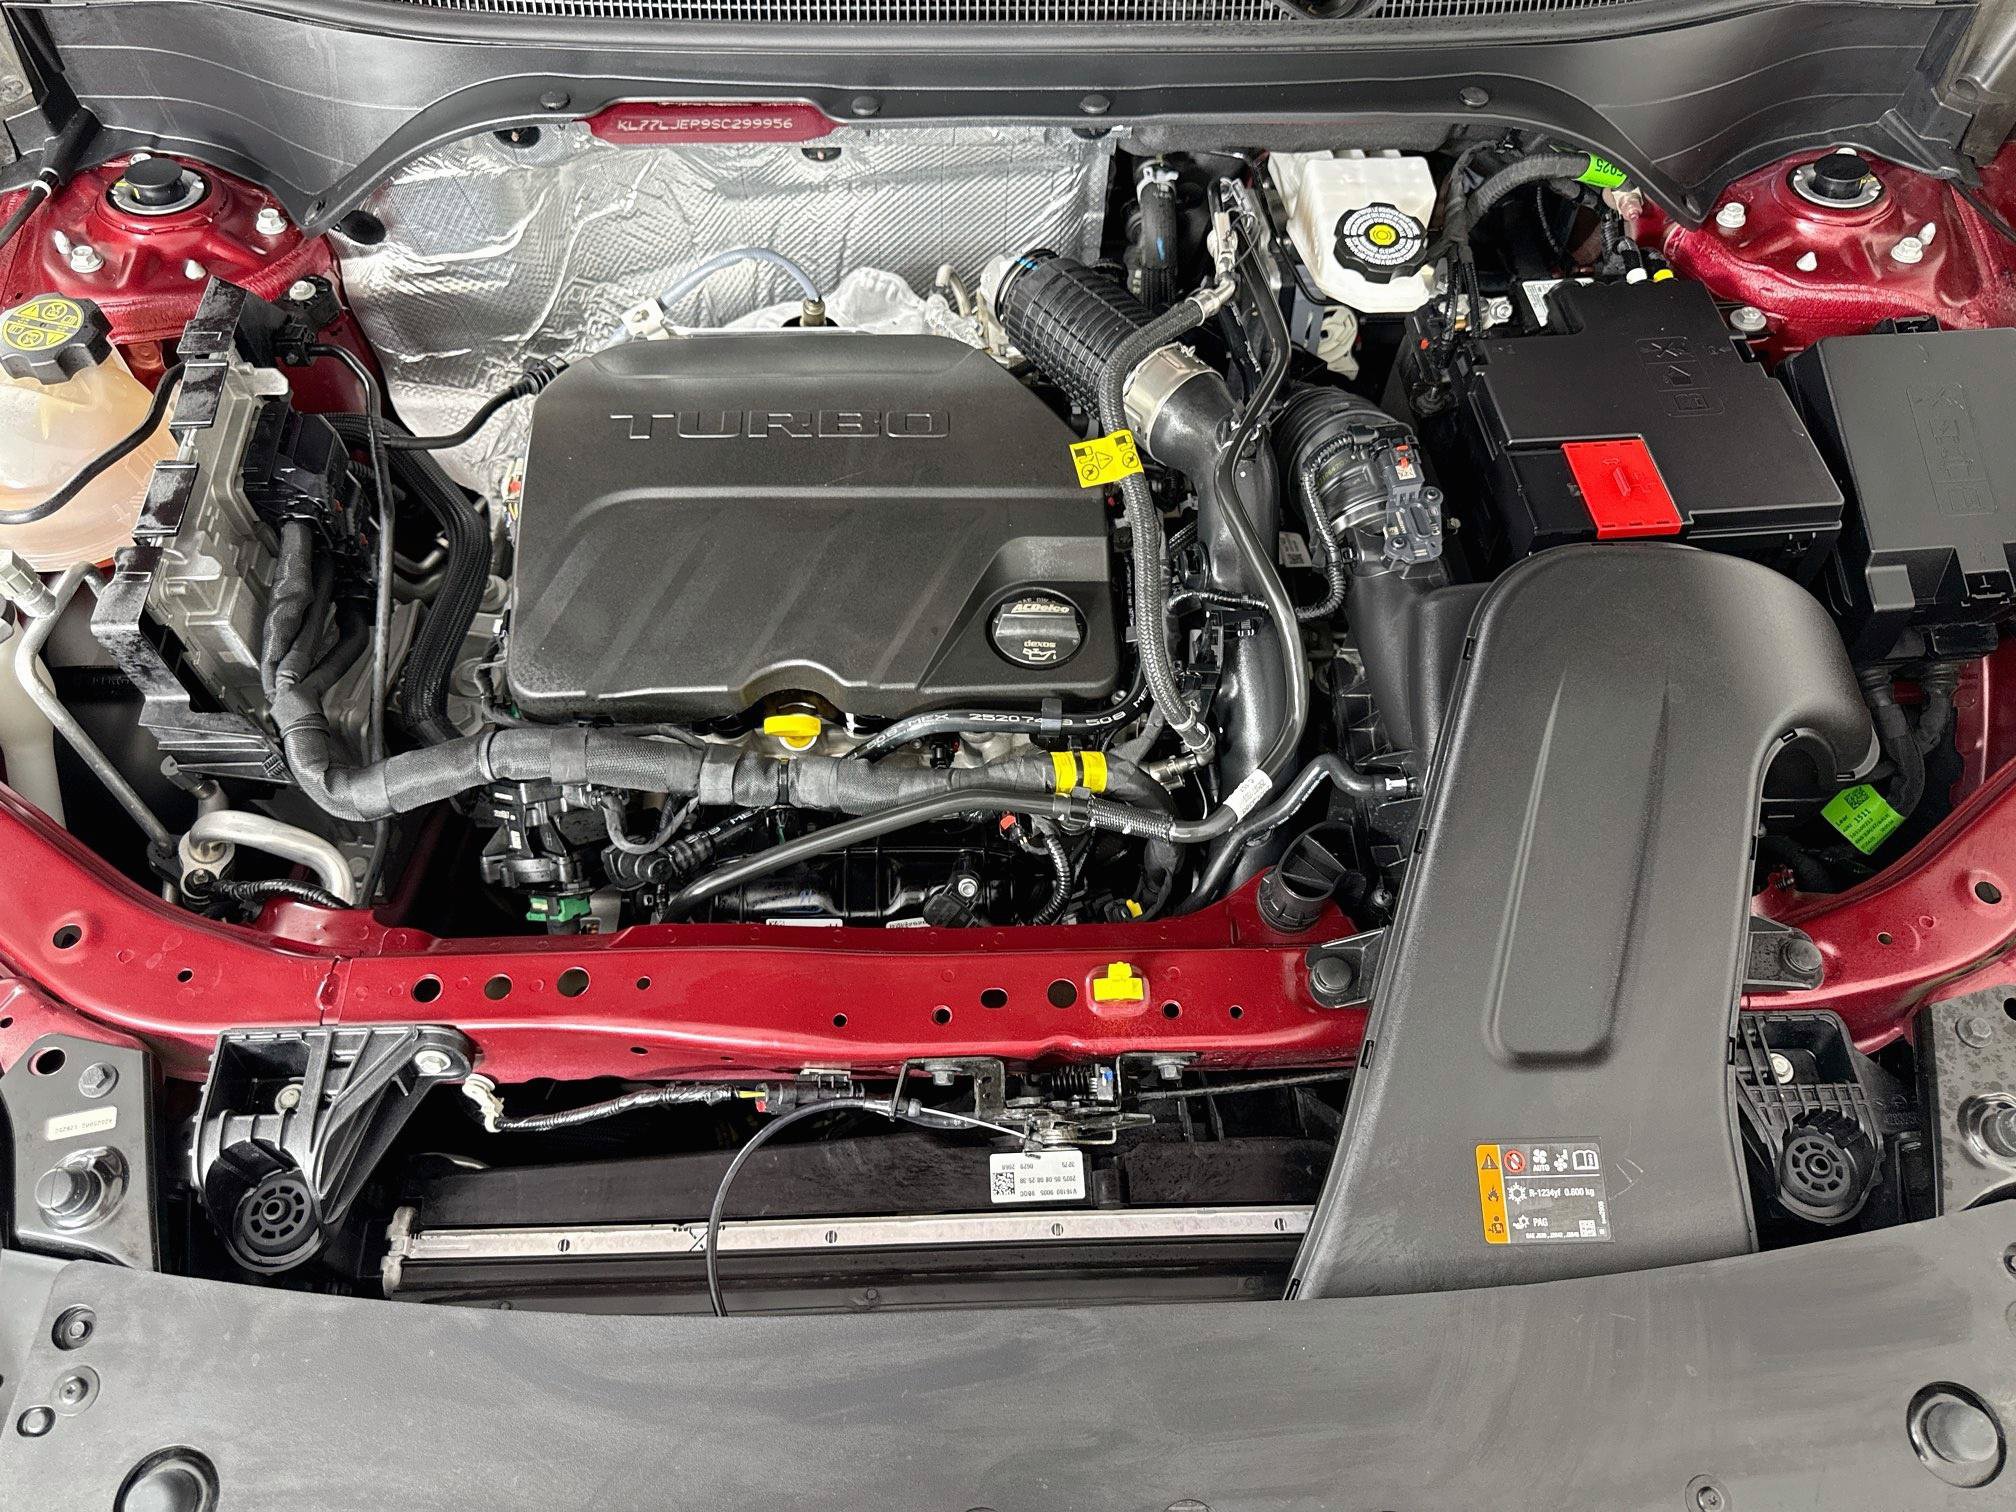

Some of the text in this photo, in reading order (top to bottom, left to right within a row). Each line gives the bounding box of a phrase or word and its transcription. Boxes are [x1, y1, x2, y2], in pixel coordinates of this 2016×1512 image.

[617, 118, 793, 131] KL77LJEP9SC299956
[609, 409, 950, 440] TURBO
[1010, 603, 1070, 614] ACDelco
[1023, 639, 1056, 648] dexos
[1086, 711, 1127, 726] 508
[1532, 1164, 1550, 1172] AUTO
[1528, 1188, 1561, 1199] R-1234yf
[1585, 1187, 1595, 1198] kg
[1532, 1217, 1549, 1227] PAG
